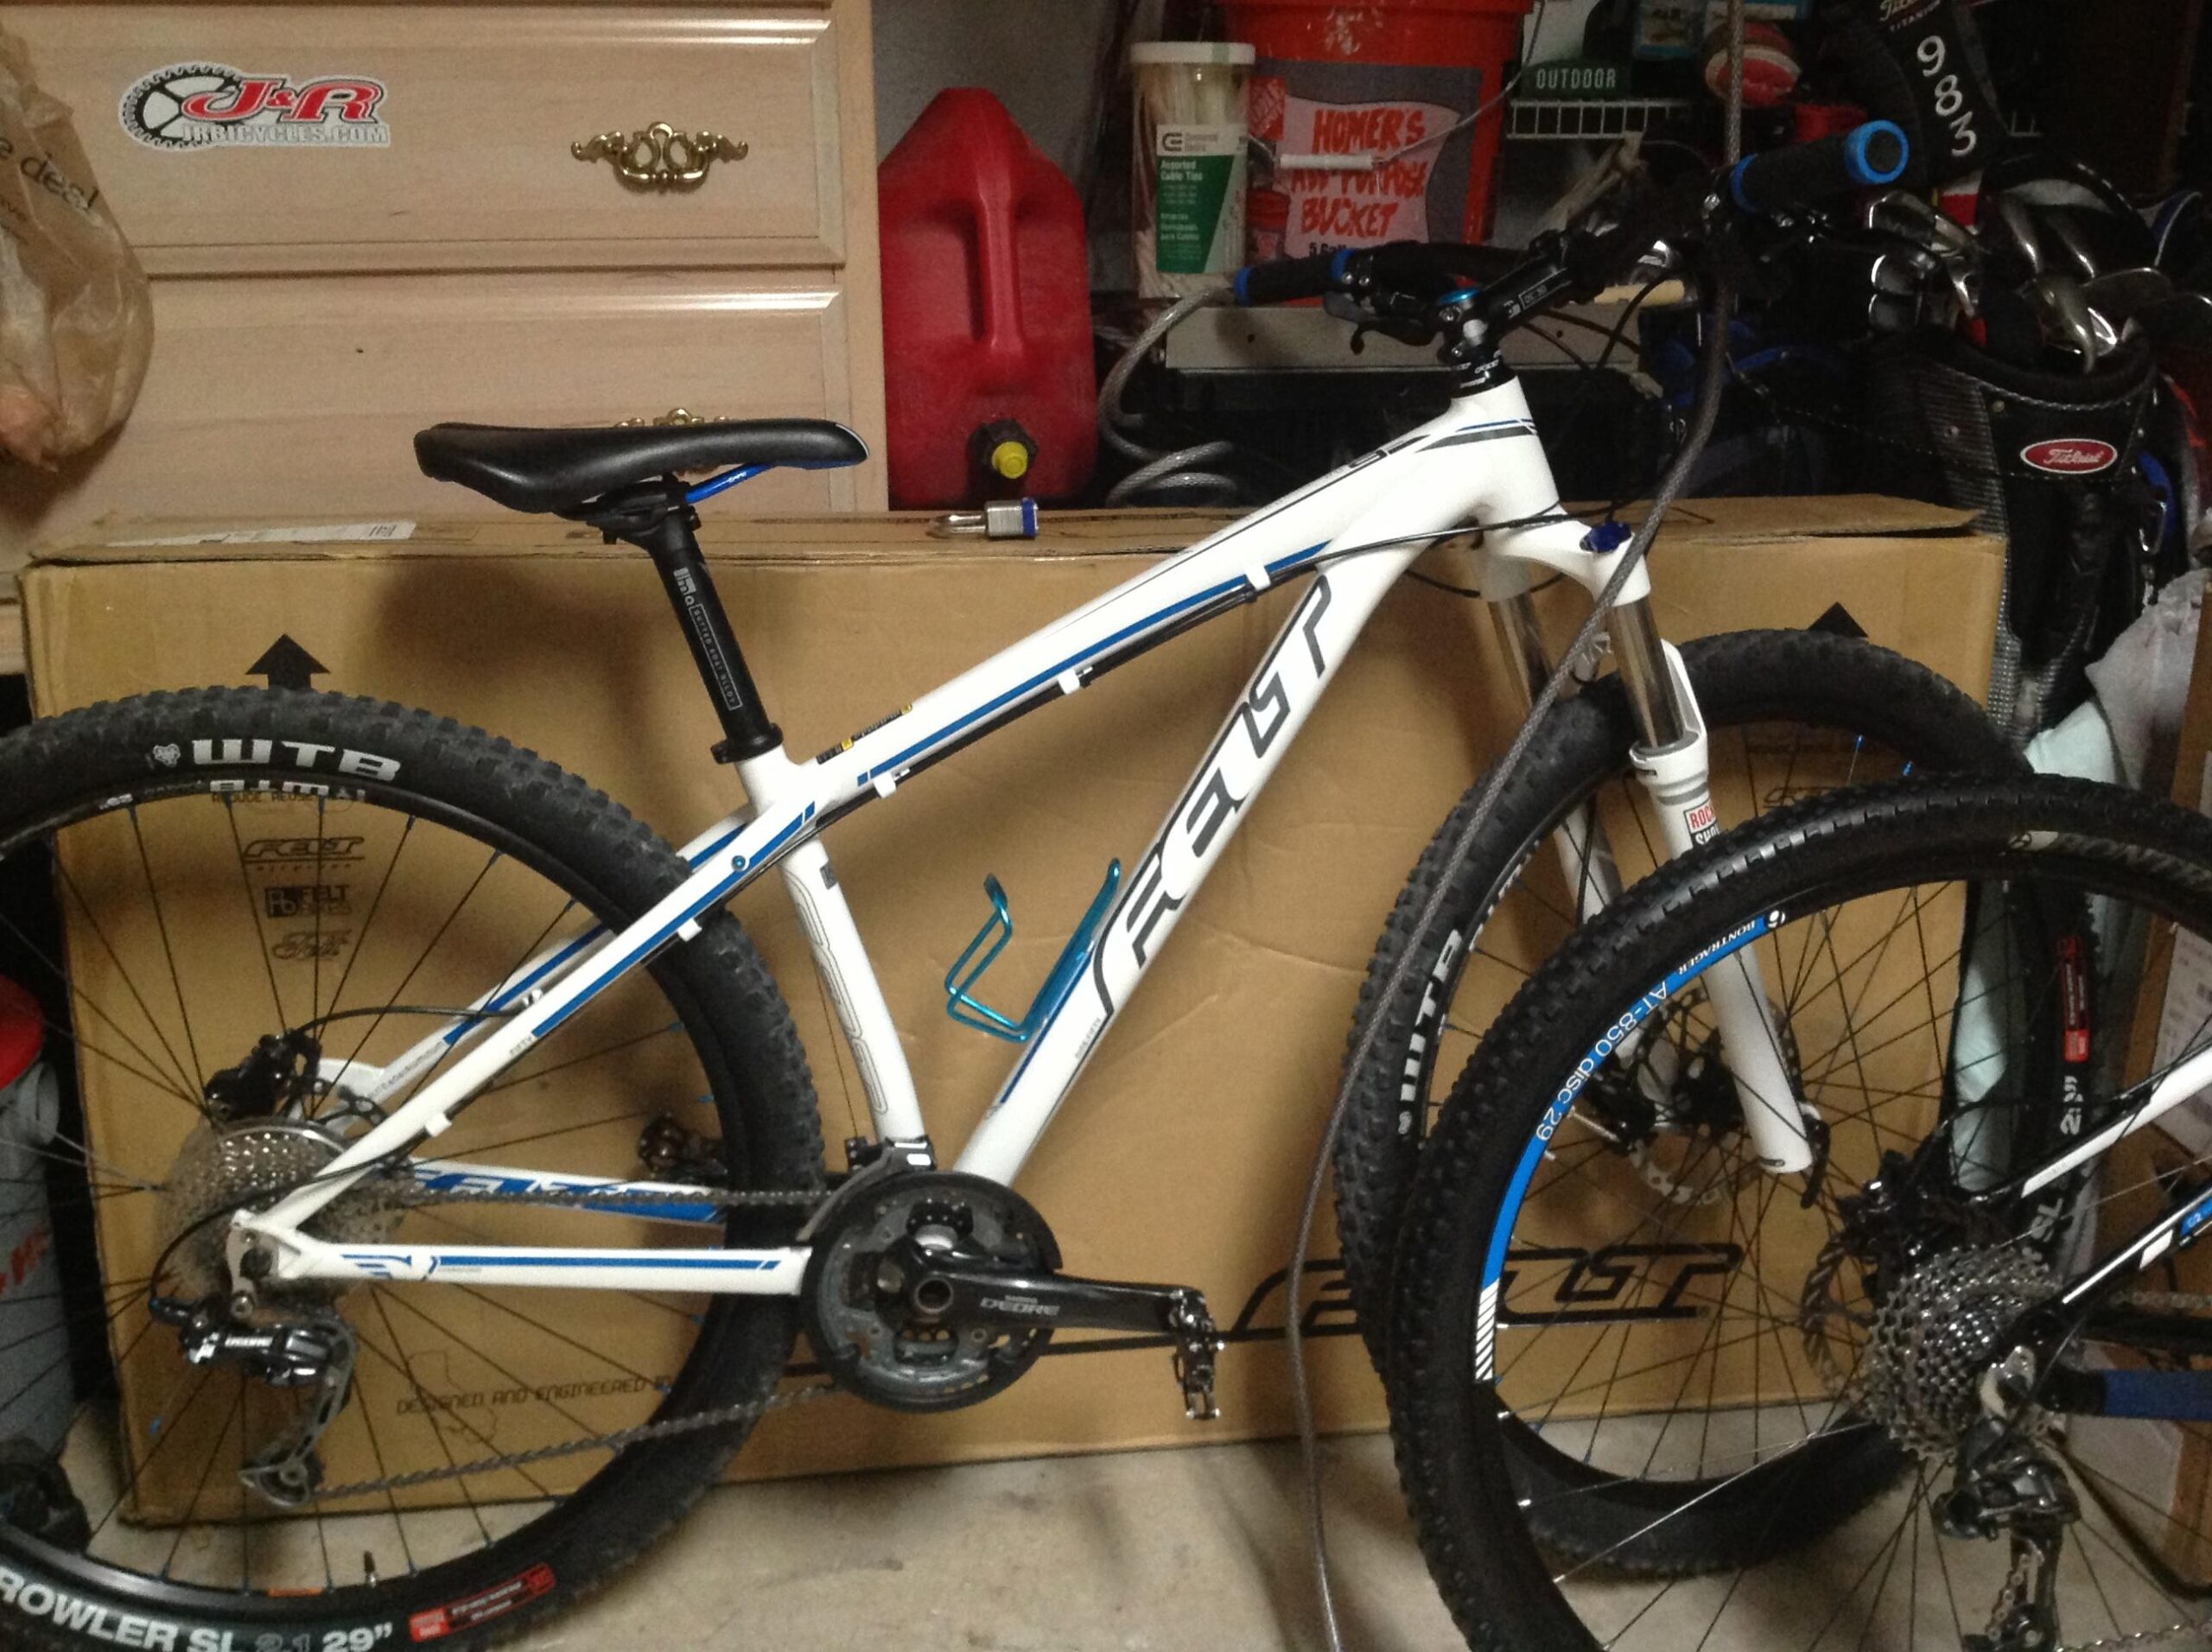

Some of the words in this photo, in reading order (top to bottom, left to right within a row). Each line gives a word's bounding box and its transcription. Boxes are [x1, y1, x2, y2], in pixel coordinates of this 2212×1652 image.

[1535, 67, 1618, 90] OUTDOOR
[1300, 197, 1399, 238] BUCKET
[191, 738, 402, 782] WTB
[1678, 919, 1756, 975] BONTRAGER
[1594, 980, 1669, 1058] AT-850
[1557, 1057, 1595, 1105] disc
[1535, 1106, 1563, 1142] 29
[397, 1391, 485, 1415] DESNED
